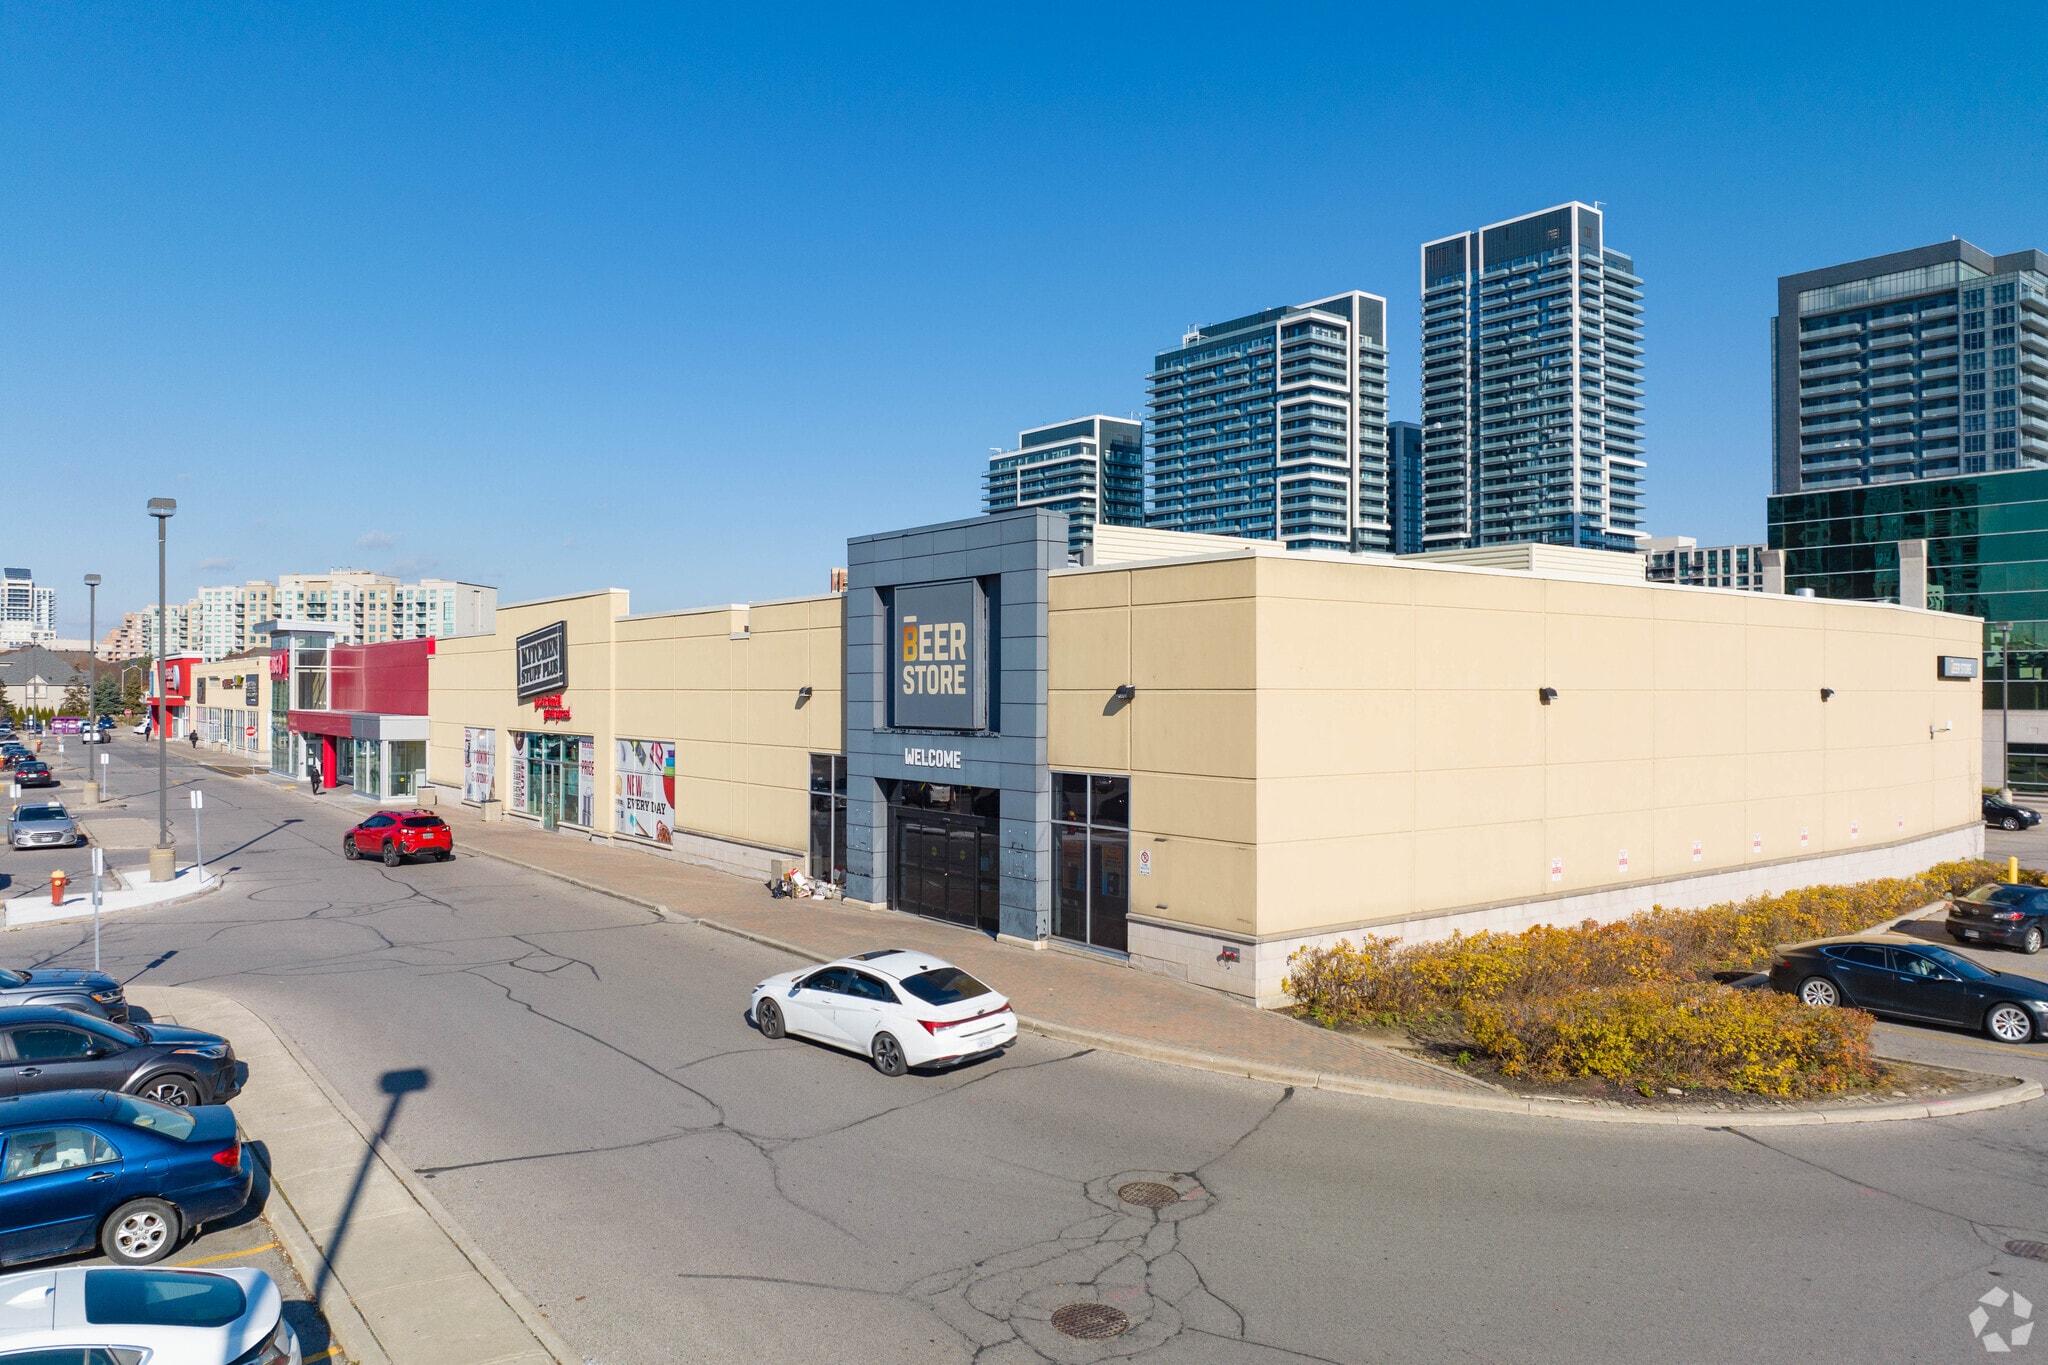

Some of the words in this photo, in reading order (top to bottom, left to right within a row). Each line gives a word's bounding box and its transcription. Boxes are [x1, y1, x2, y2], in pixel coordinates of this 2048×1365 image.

[521, 636, 558, 668] KITCHEN
[903, 616, 967, 662] BEER
[521, 664, 542, 685] STUFF
[542, 658, 559, 678] PLUS
[903, 664, 967, 695] STORE
[904, 747, 962, 769] WELCOME
[627, 774, 643, 797] NEW
[627, 798, 650, 812] EVERY
[650, 801, 667, 815] DAY
